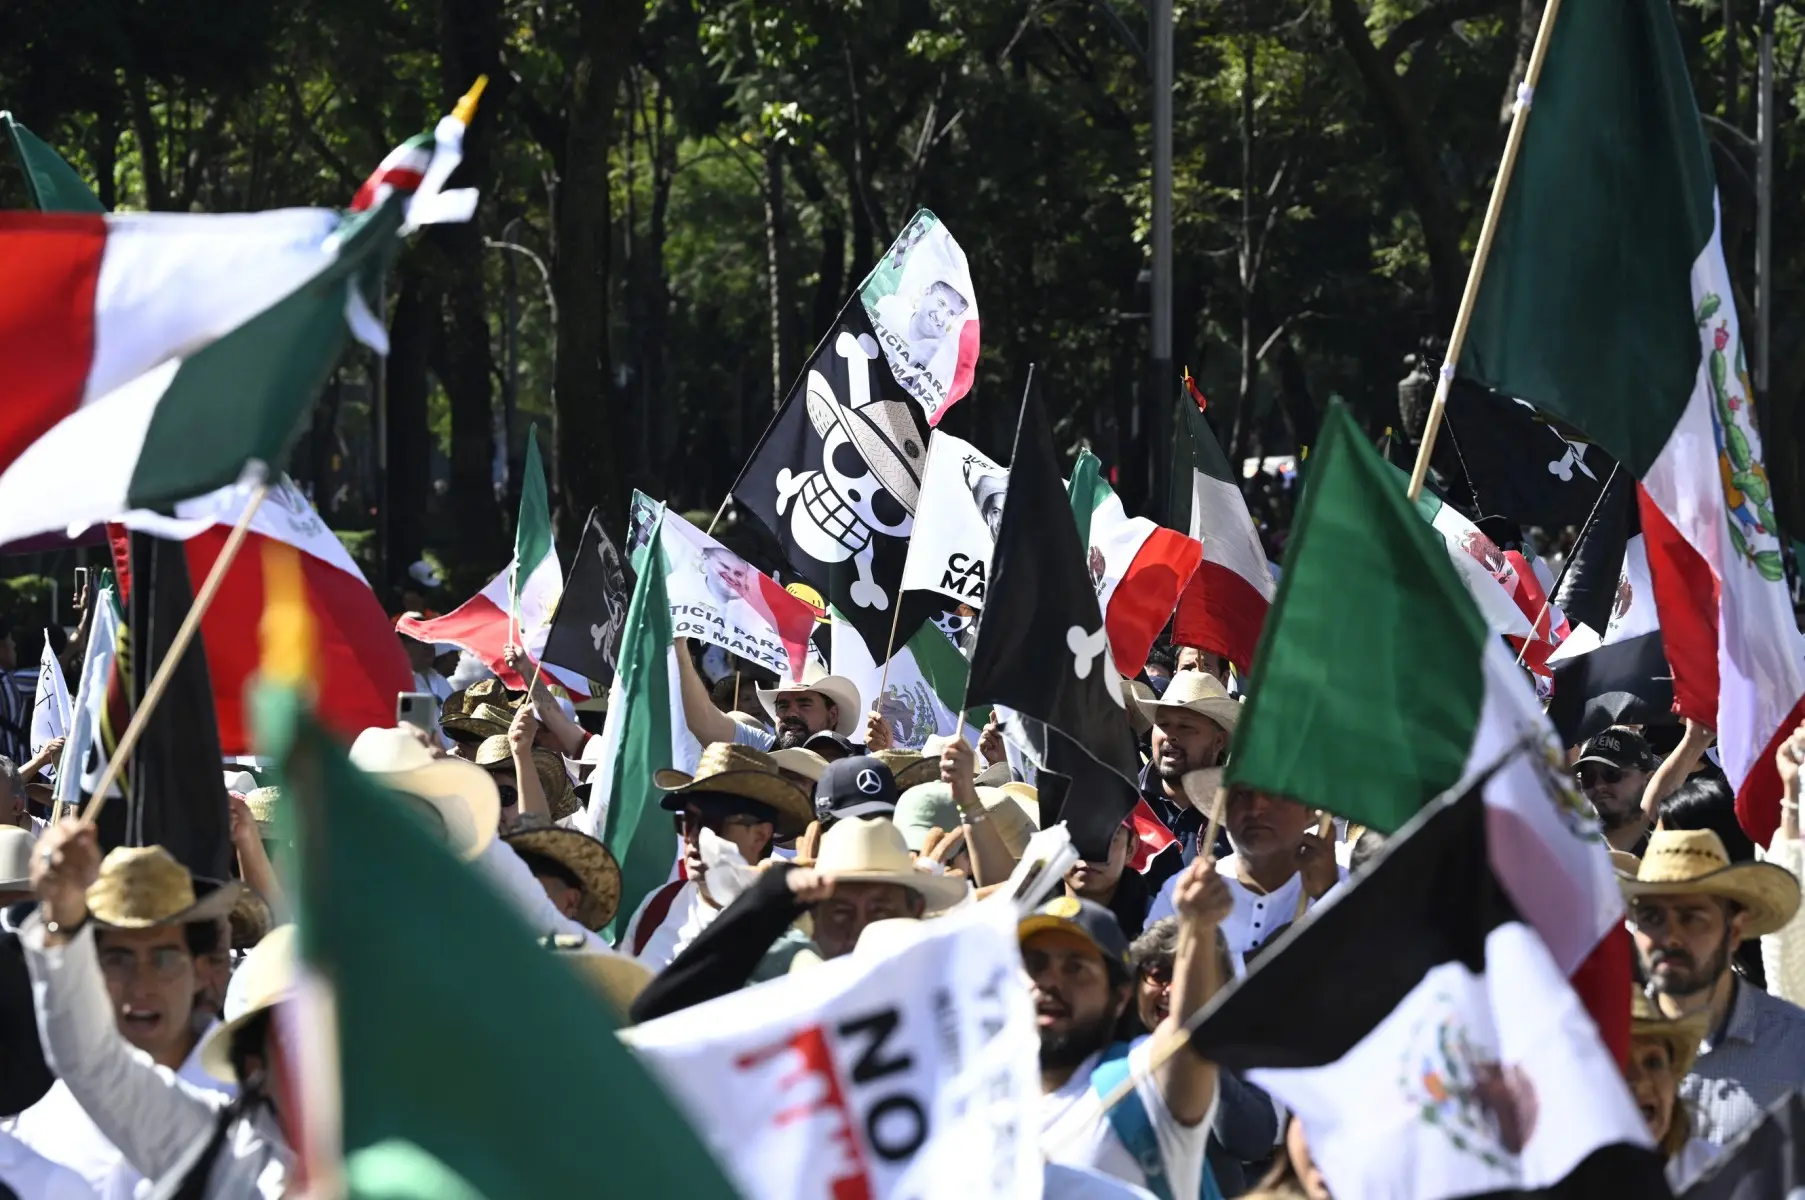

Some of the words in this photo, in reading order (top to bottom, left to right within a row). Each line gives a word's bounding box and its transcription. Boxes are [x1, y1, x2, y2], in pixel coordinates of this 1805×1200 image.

[868, 315, 909, 362] TICIA
[914, 362, 947, 401] PARA
[891, 362, 937, 413] MANZO
[673, 621, 705, 634] OS
[713, 631, 788, 671] MANZO
[734, 626, 788, 657] PARA
[839, 1005, 930, 1163] NO
